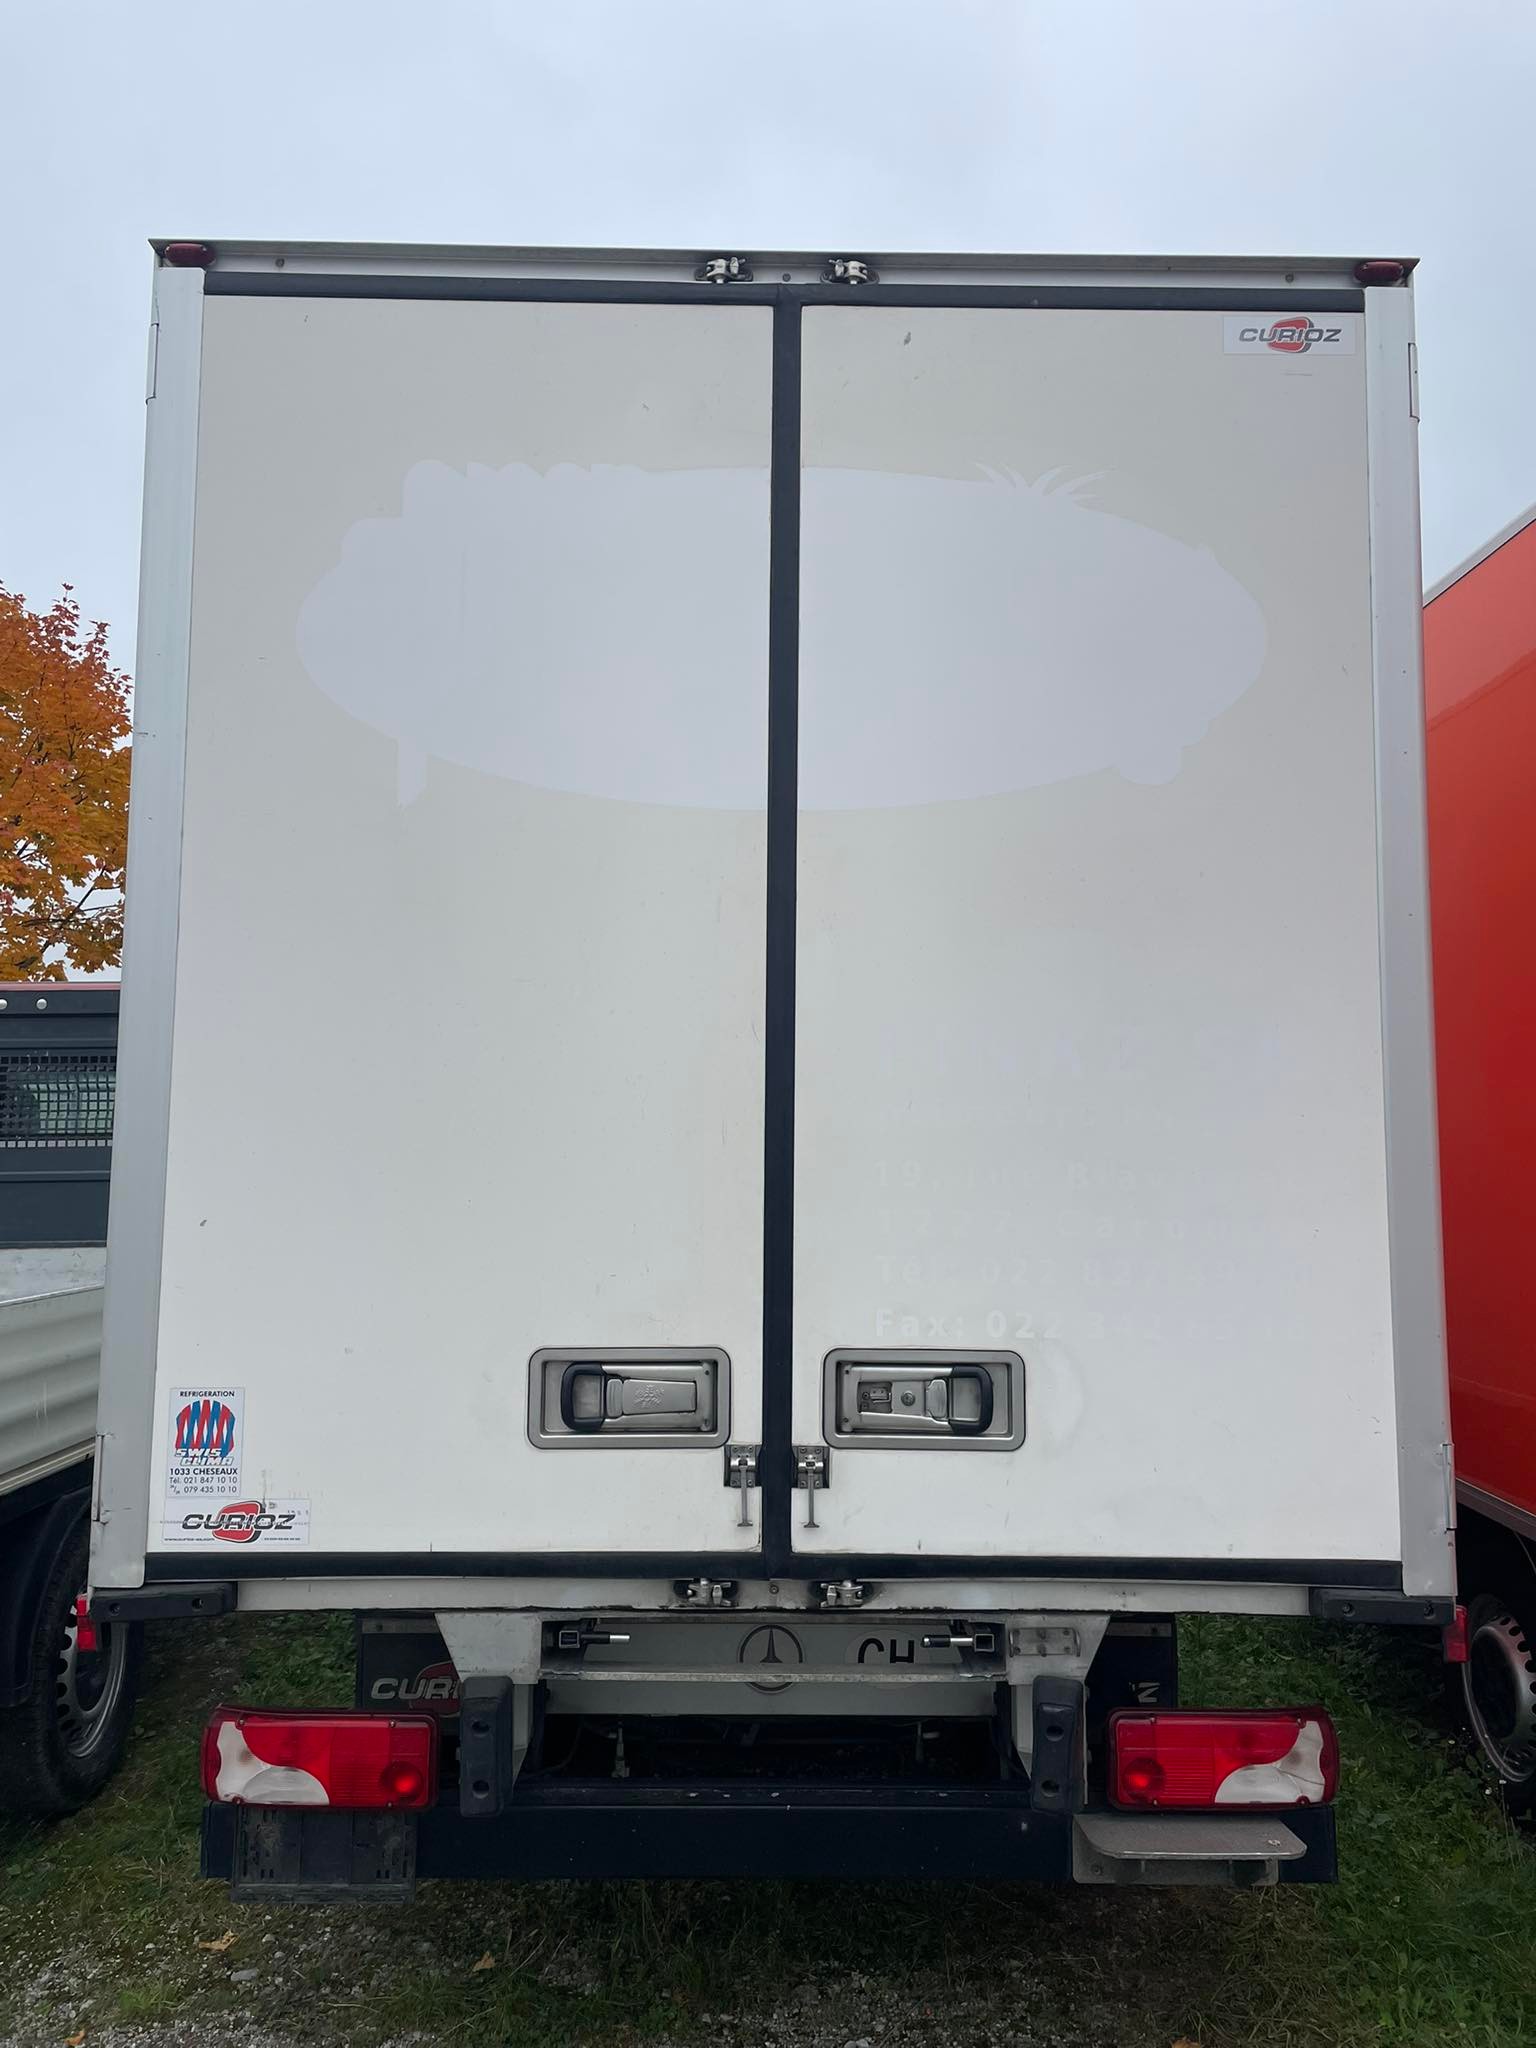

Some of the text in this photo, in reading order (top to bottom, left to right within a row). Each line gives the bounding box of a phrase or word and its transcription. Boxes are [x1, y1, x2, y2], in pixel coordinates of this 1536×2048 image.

[1239, 328, 1342, 342] CURIOZ
[874, 1308, 965, 1339] Fax:
[180, 1457, 234, 1466] CLIMA
[169, 1467, 238, 1476] 1033 CHESEAUX
[183, 1476, 198, 1484] 021
[200, 1476, 214, 1484] 847
[217, 1476, 226, 1484] 10
[228, 1476, 238, 1484] 10
[183, 1485, 198, 1494] 079
[199, 1485, 214, 1494] 435
[217, 1485, 226, 1493] 10
[228, 1485, 237, 1493] 10
[182, 1514, 295, 1530] CURIOZ
[858, 1637, 915, 1664] CH
